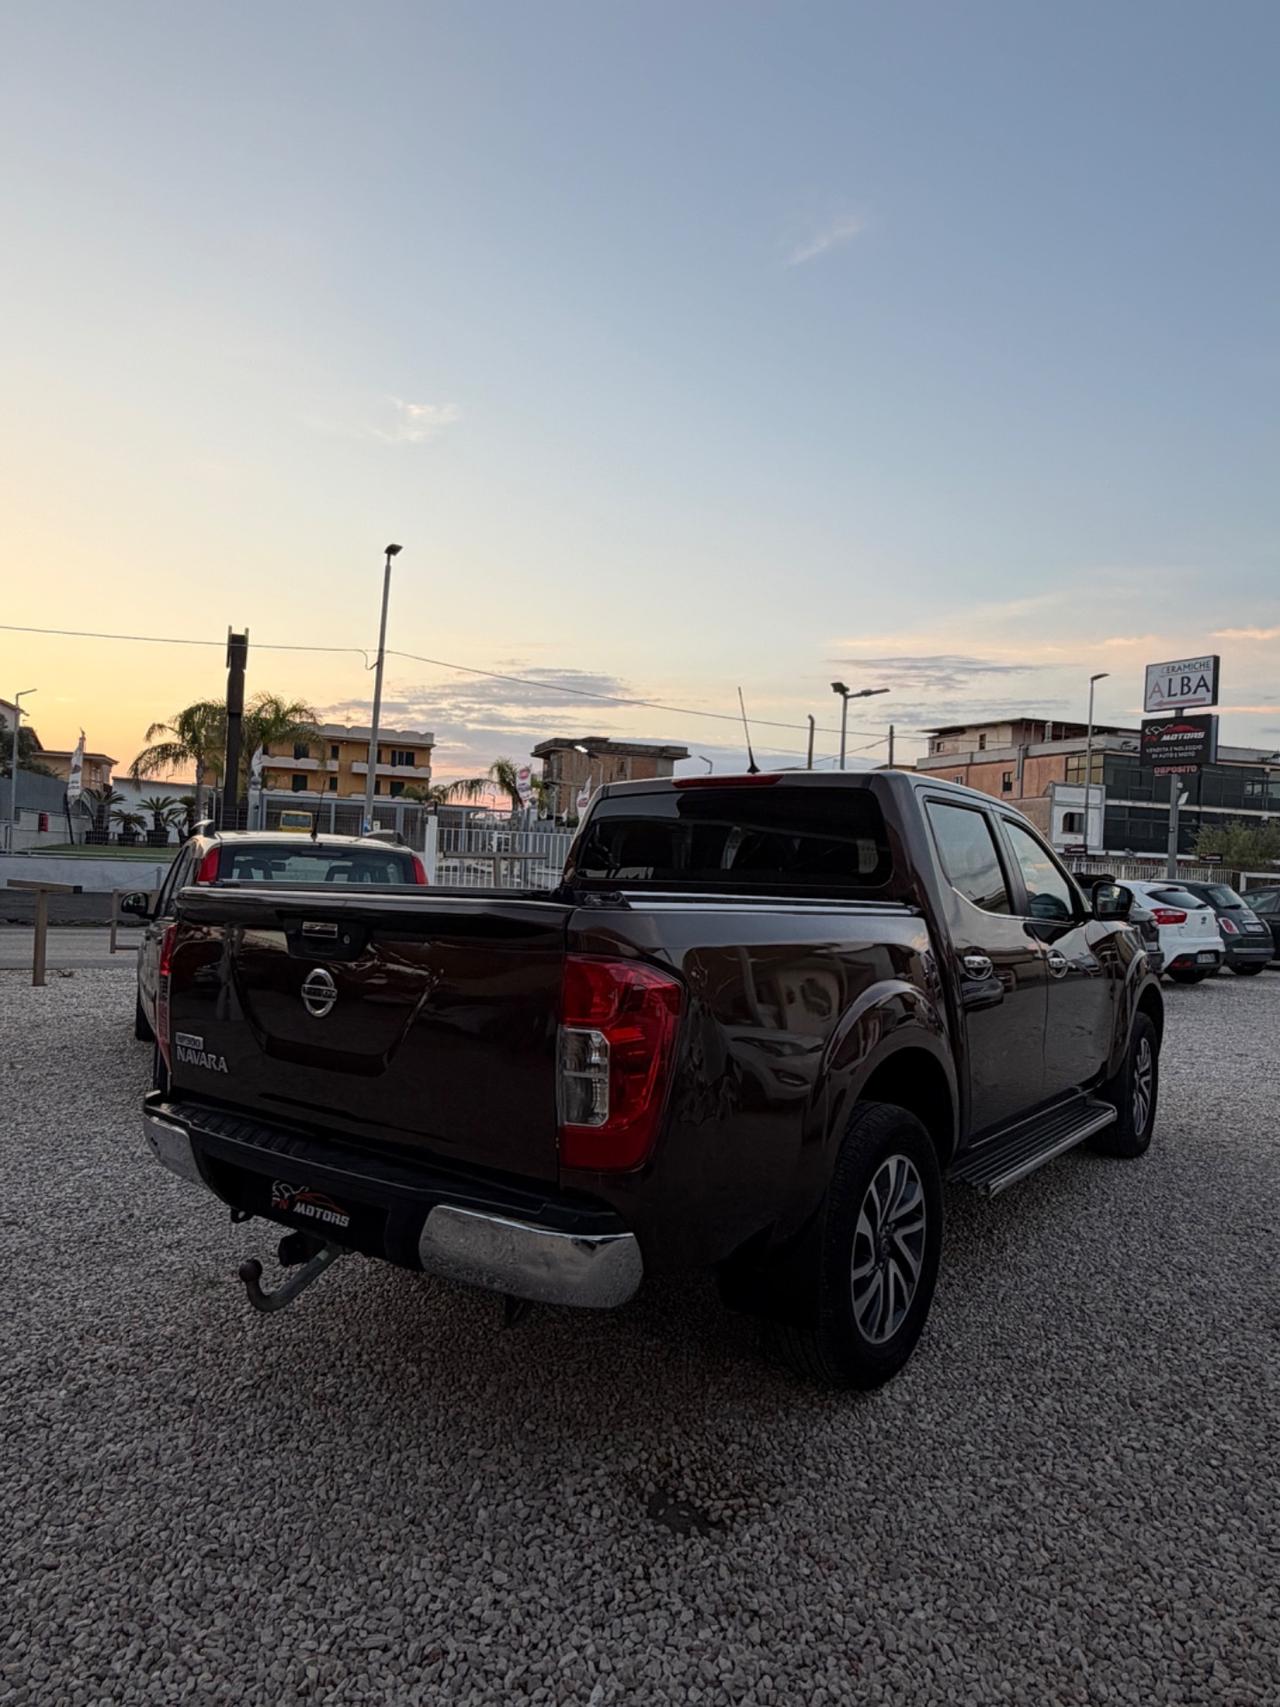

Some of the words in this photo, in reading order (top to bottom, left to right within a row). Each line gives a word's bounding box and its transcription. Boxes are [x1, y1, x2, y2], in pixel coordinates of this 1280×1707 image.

[1161, 661, 1211, 673] CERAMICHE
[1148, 674, 1211, 700] ALBA
[1161, 731, 1205, 741] MOTORS
[1153, 765, 1198, 774] DEPOSITO
[177, 1046, 228, 1073] NAVARA
[293, 1202, 350, 1228] MOTORS
